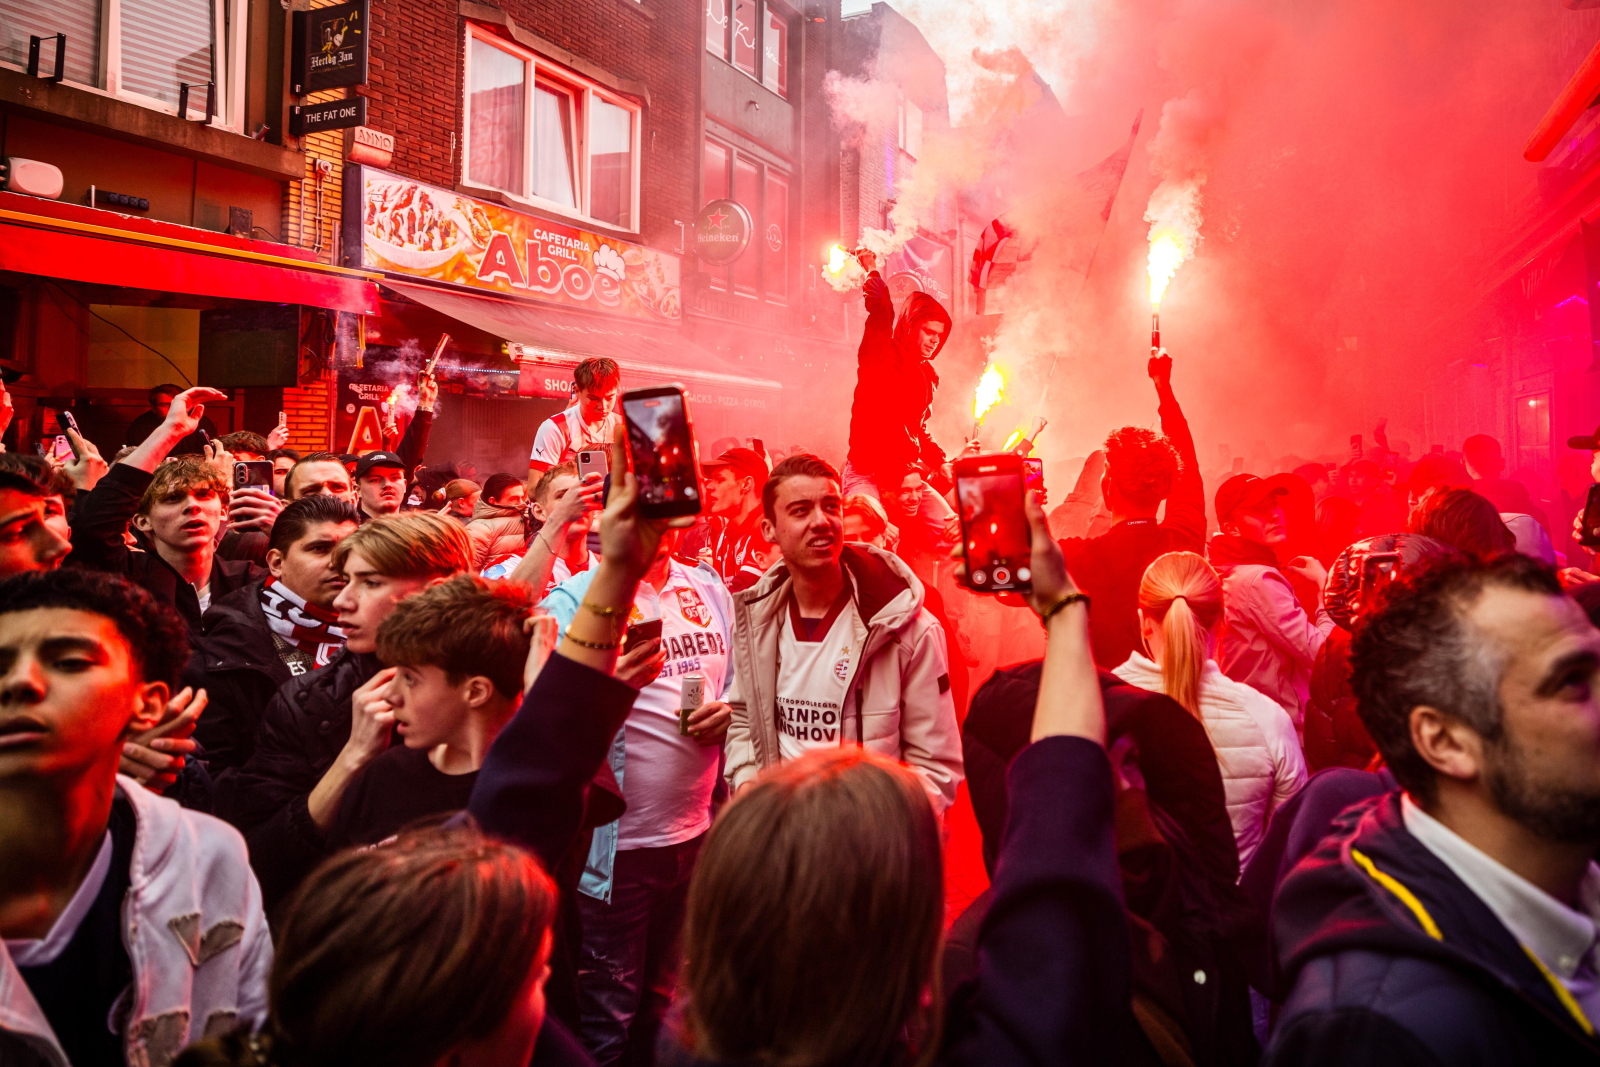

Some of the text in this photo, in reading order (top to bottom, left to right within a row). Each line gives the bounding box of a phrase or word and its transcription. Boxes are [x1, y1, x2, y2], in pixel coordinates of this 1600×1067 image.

[338, 51, 353, 65] Jan
[306, 107, 356, 123] THE FAT ONE
[534, 229, 590, 252] CAFETARIA
[697, 232, 739, 243] Heineken
[548, 245, 577, 260] GRILL
[476, 230, 620, 306] Aboe
[358, 393, 379, 401] GRILL
[718, 396, 739, 406] PIZZA
[744, 399, 766, 409] GYROS
[658, 657, 701, 679] ST 1995
[780, 706, 840, 726] AINPO
